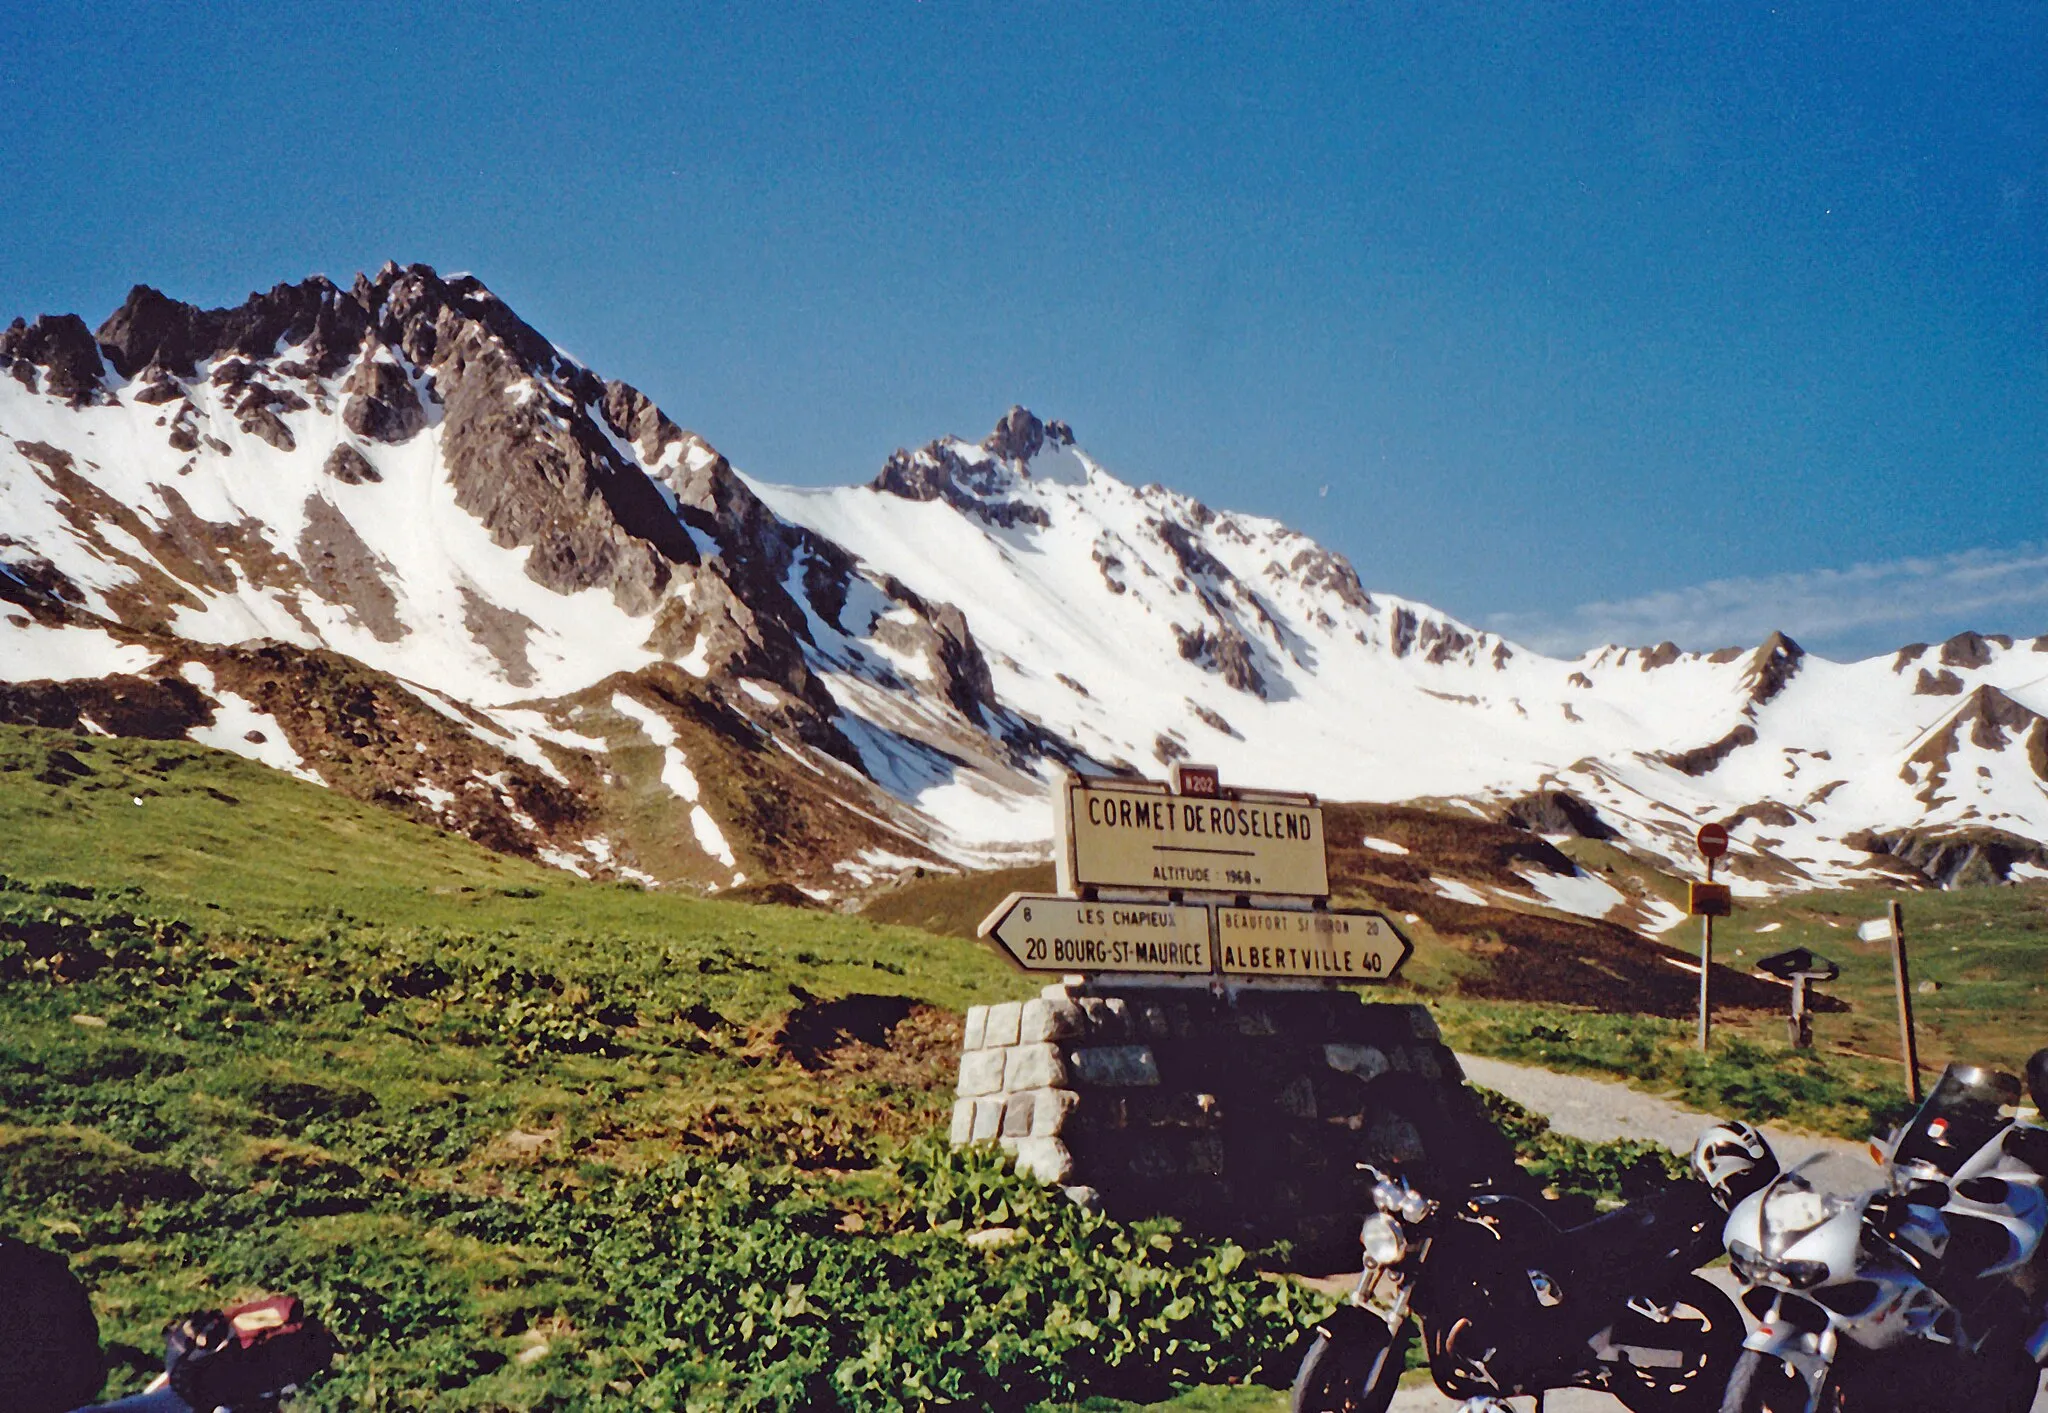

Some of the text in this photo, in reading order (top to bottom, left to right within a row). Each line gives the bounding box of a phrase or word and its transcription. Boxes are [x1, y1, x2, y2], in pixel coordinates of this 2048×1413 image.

[1089, 797, 1311, 841] CORMET DE ROSELEND
[1153, 866, 1210, 882] ALTITUDE
[1023, 908, 1176, 927] 8 LES CHAPIEUX
[1225, 914, 1288, 931] BEAUFORT
[1026, 937, 1203, 965] 20 BOURG-ST-MAURICE
[1225, 946, 1383, 972] ALBERTVILLE 40
